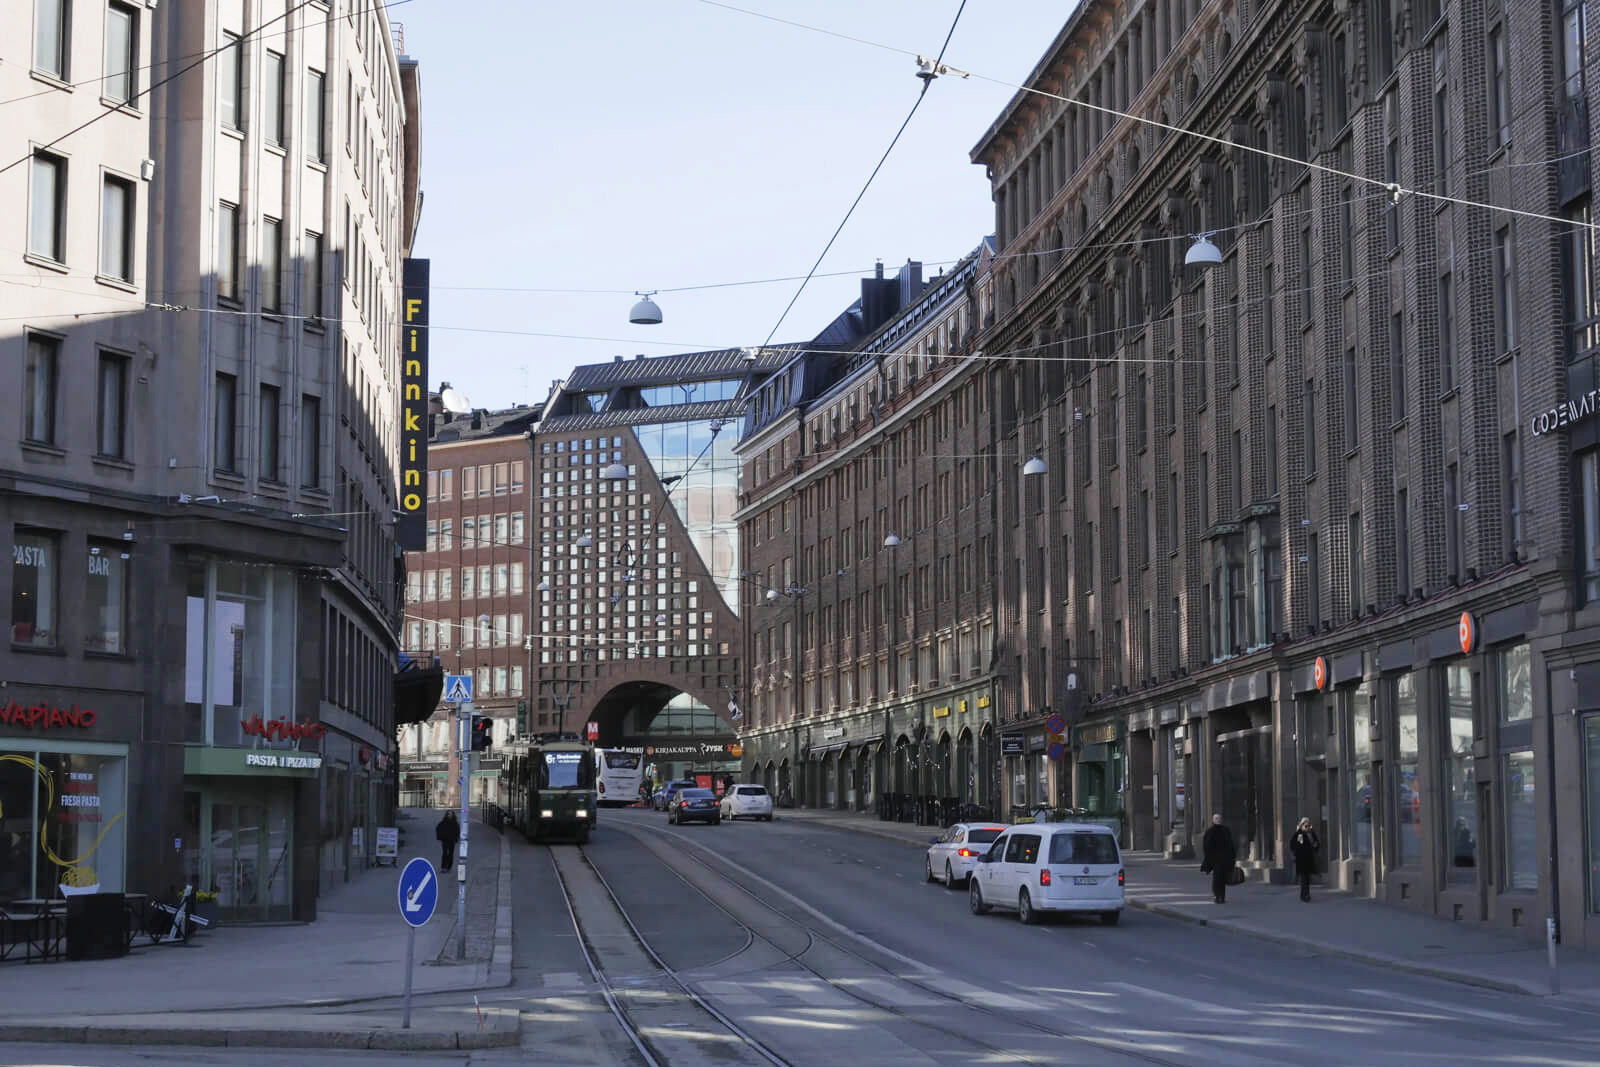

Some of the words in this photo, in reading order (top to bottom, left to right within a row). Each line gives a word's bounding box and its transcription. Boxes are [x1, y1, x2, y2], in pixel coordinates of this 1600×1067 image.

[404, 299, 422, 511] Finnkino
[88, 556, 110, 576] BAR
[704, 744, 723, 752] JYSK
[246, 754, 278, 768] PASTA
